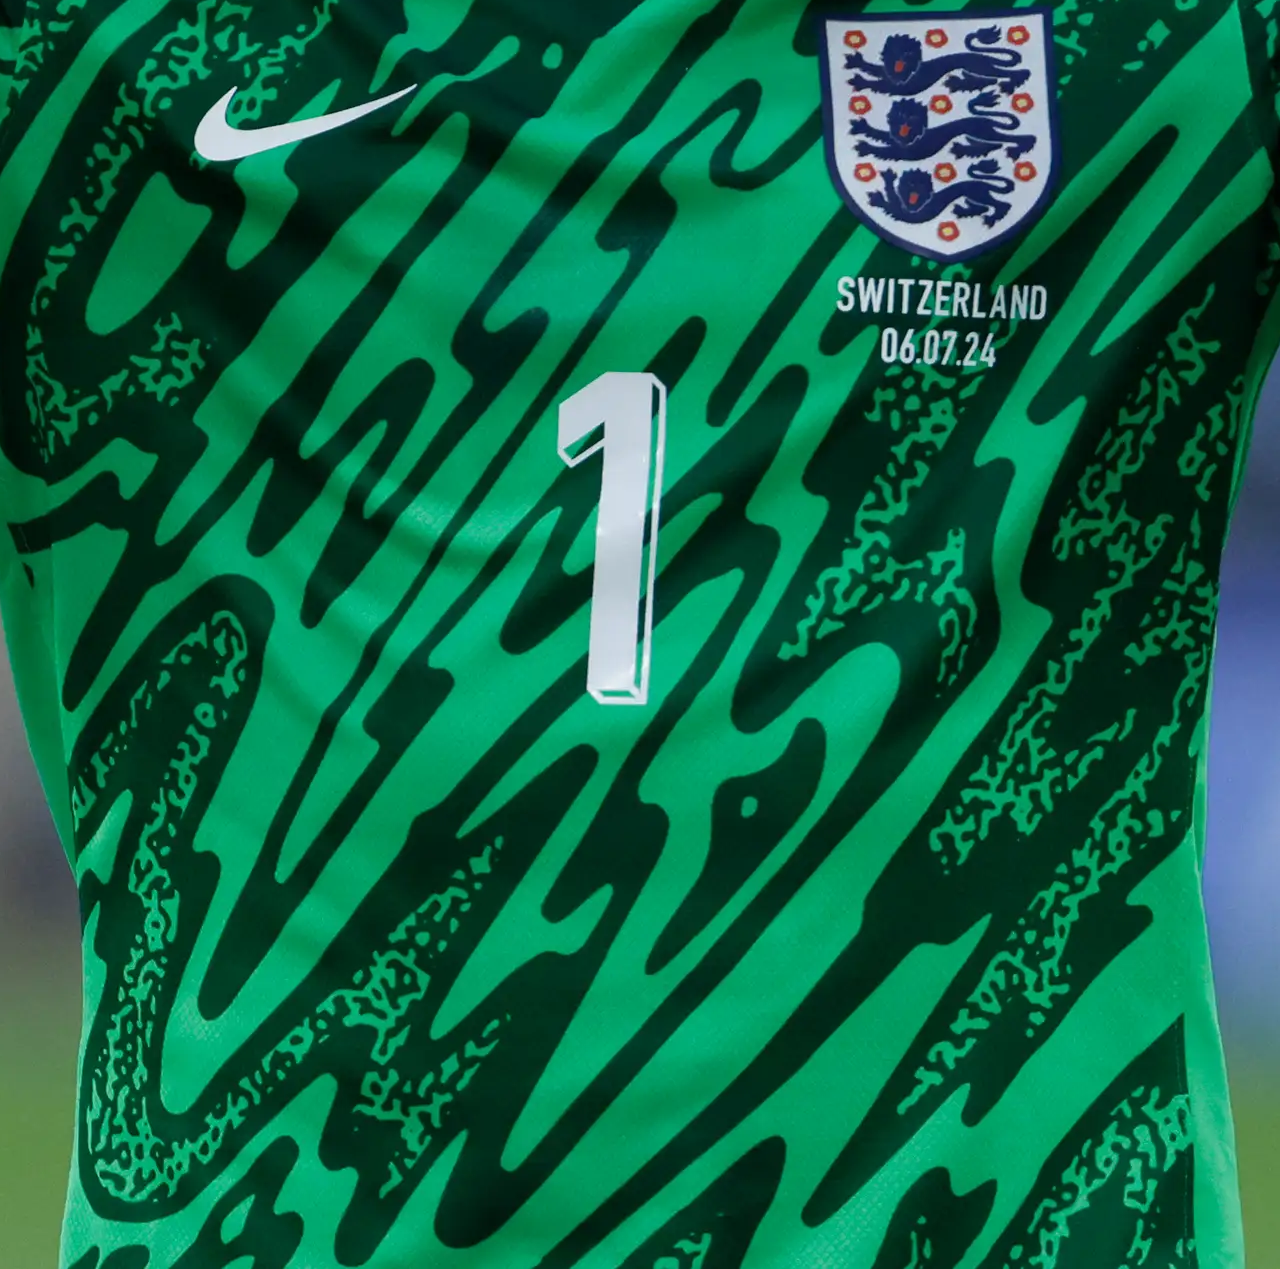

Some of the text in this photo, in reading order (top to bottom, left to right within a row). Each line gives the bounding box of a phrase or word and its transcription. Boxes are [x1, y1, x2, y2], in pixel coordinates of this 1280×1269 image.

[836, 276, 1048, 320] SWITZERLAND
[880, 327, 997, 368] 06.07.24
[557, 371, 667, 705] 1
